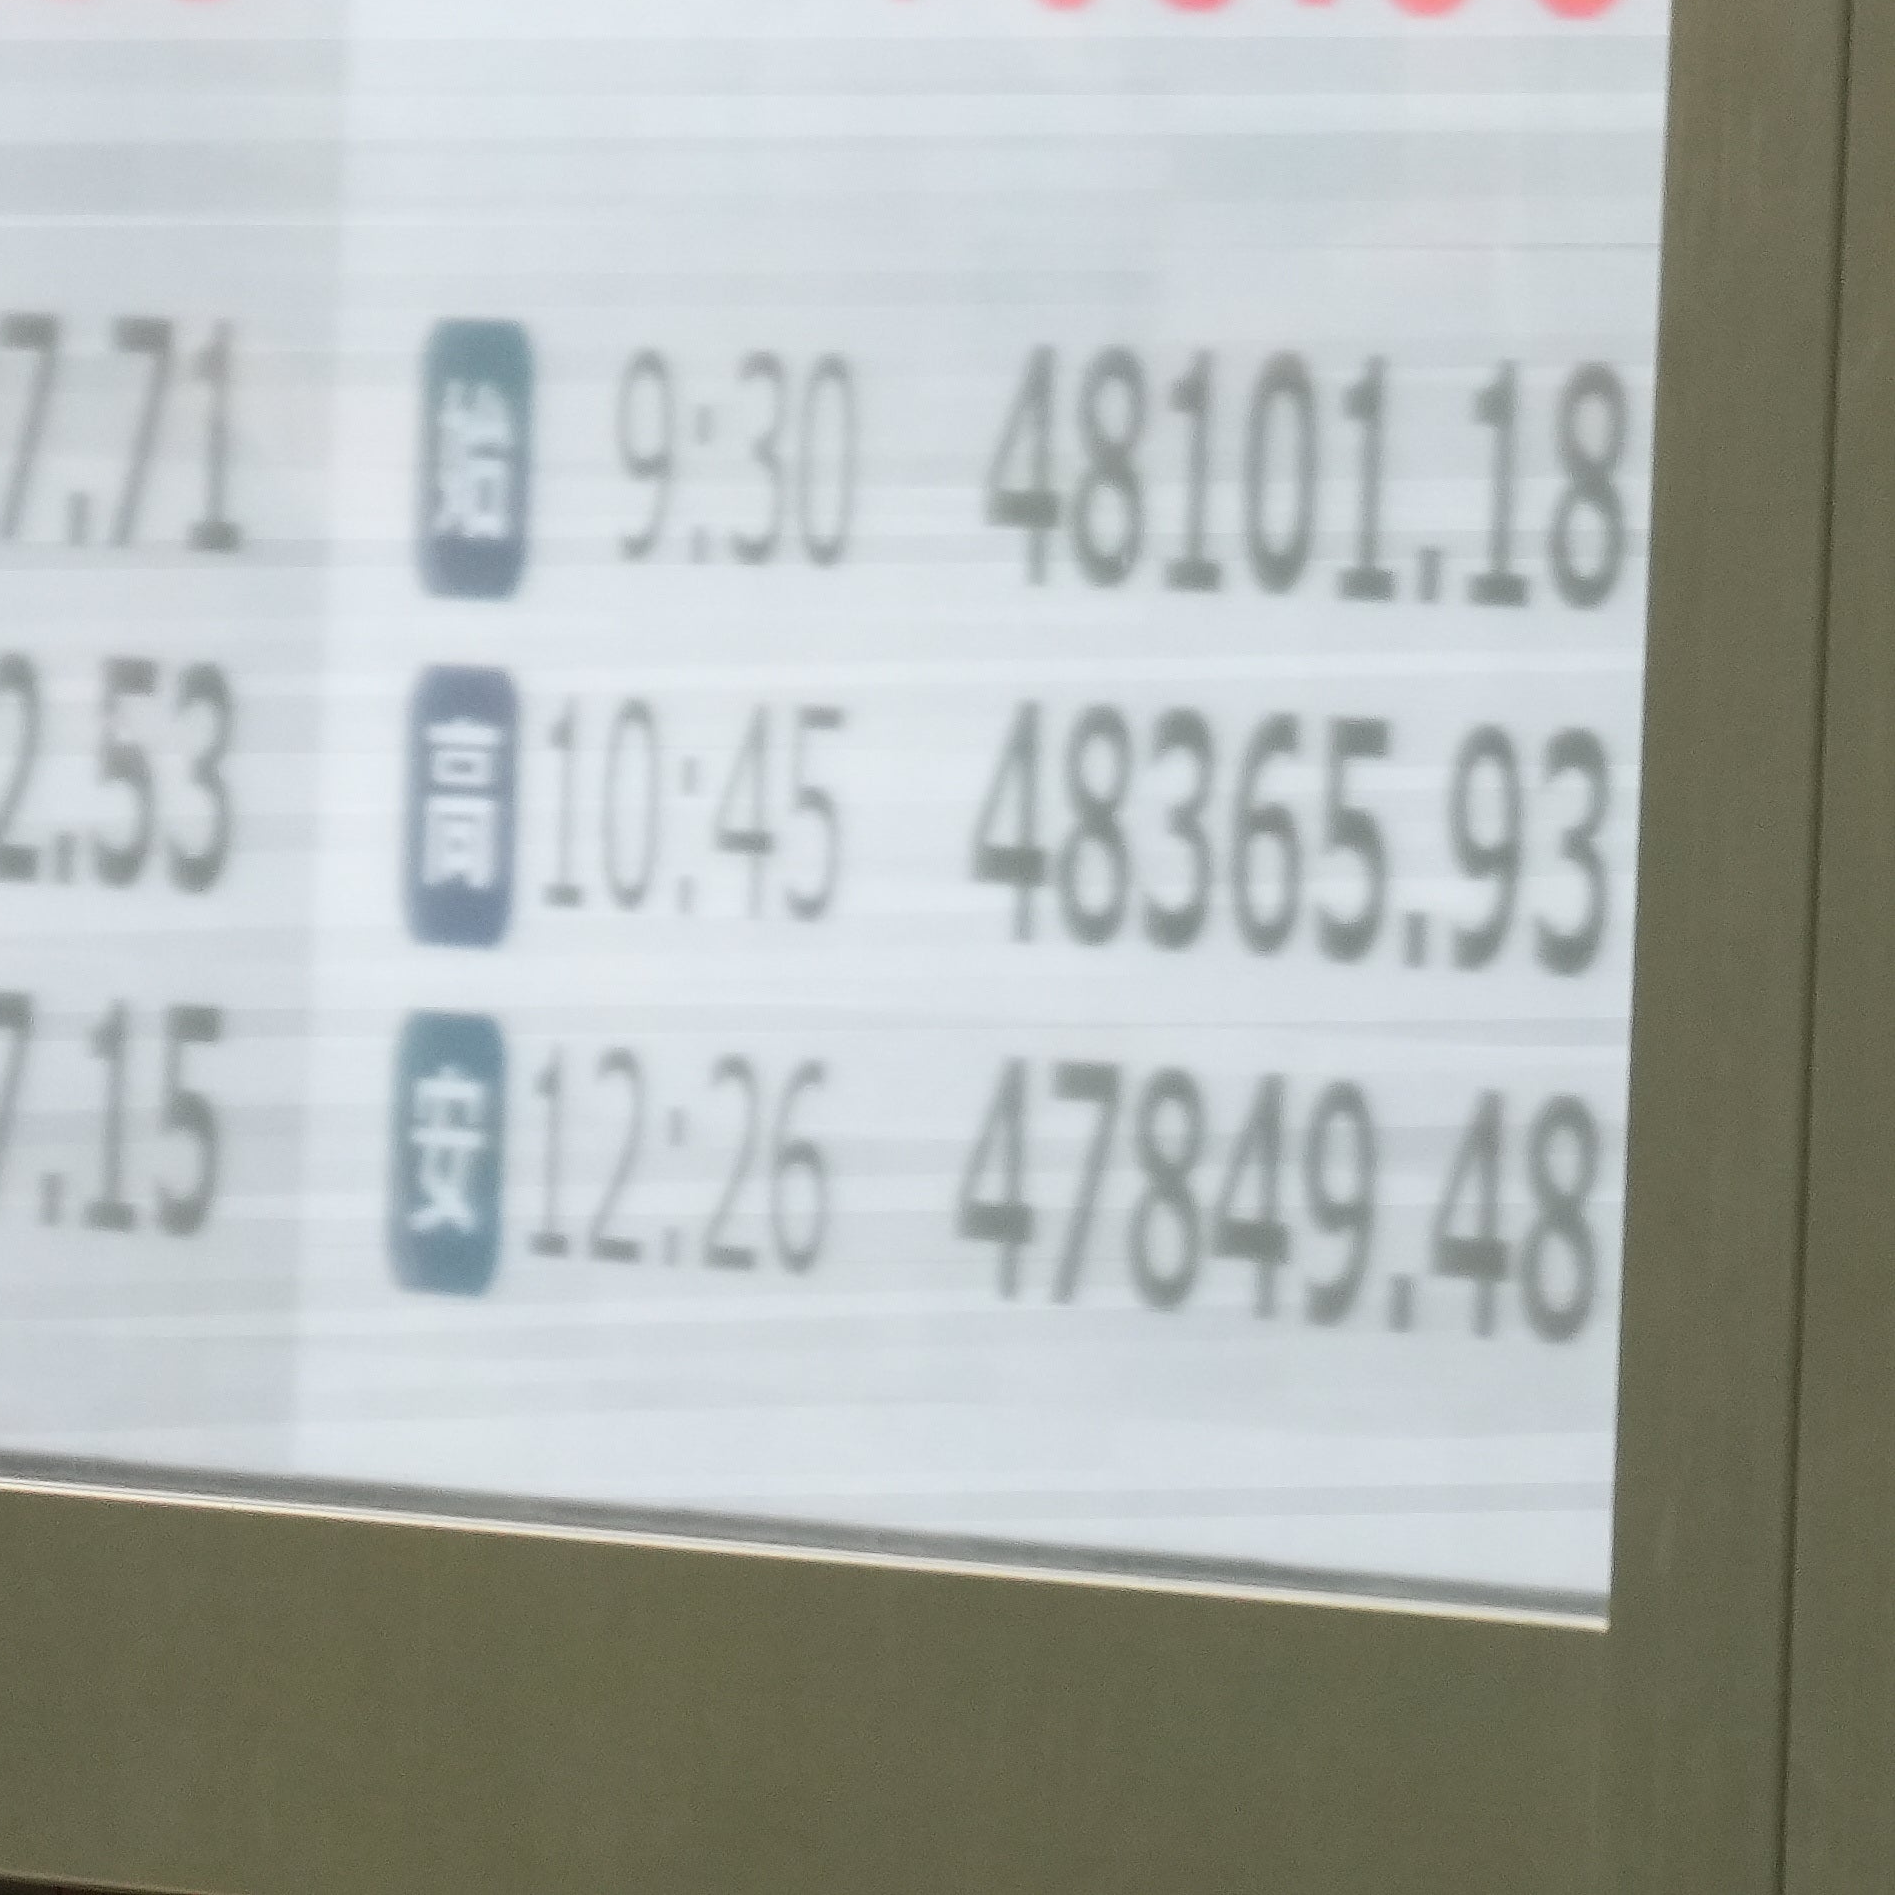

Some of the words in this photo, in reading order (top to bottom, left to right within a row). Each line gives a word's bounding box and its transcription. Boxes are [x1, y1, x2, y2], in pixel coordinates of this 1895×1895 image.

[615, 347, 856, 567] 9:30
[984, 342, 1634, 611] 48101.18
[541, 696, 847, 922] 10:45
[970, 701, 1612, 976] 48365.93
[529, 1043, 828, 1275] 12:26
[954, 1055, 1599, 1344] 47849.48
